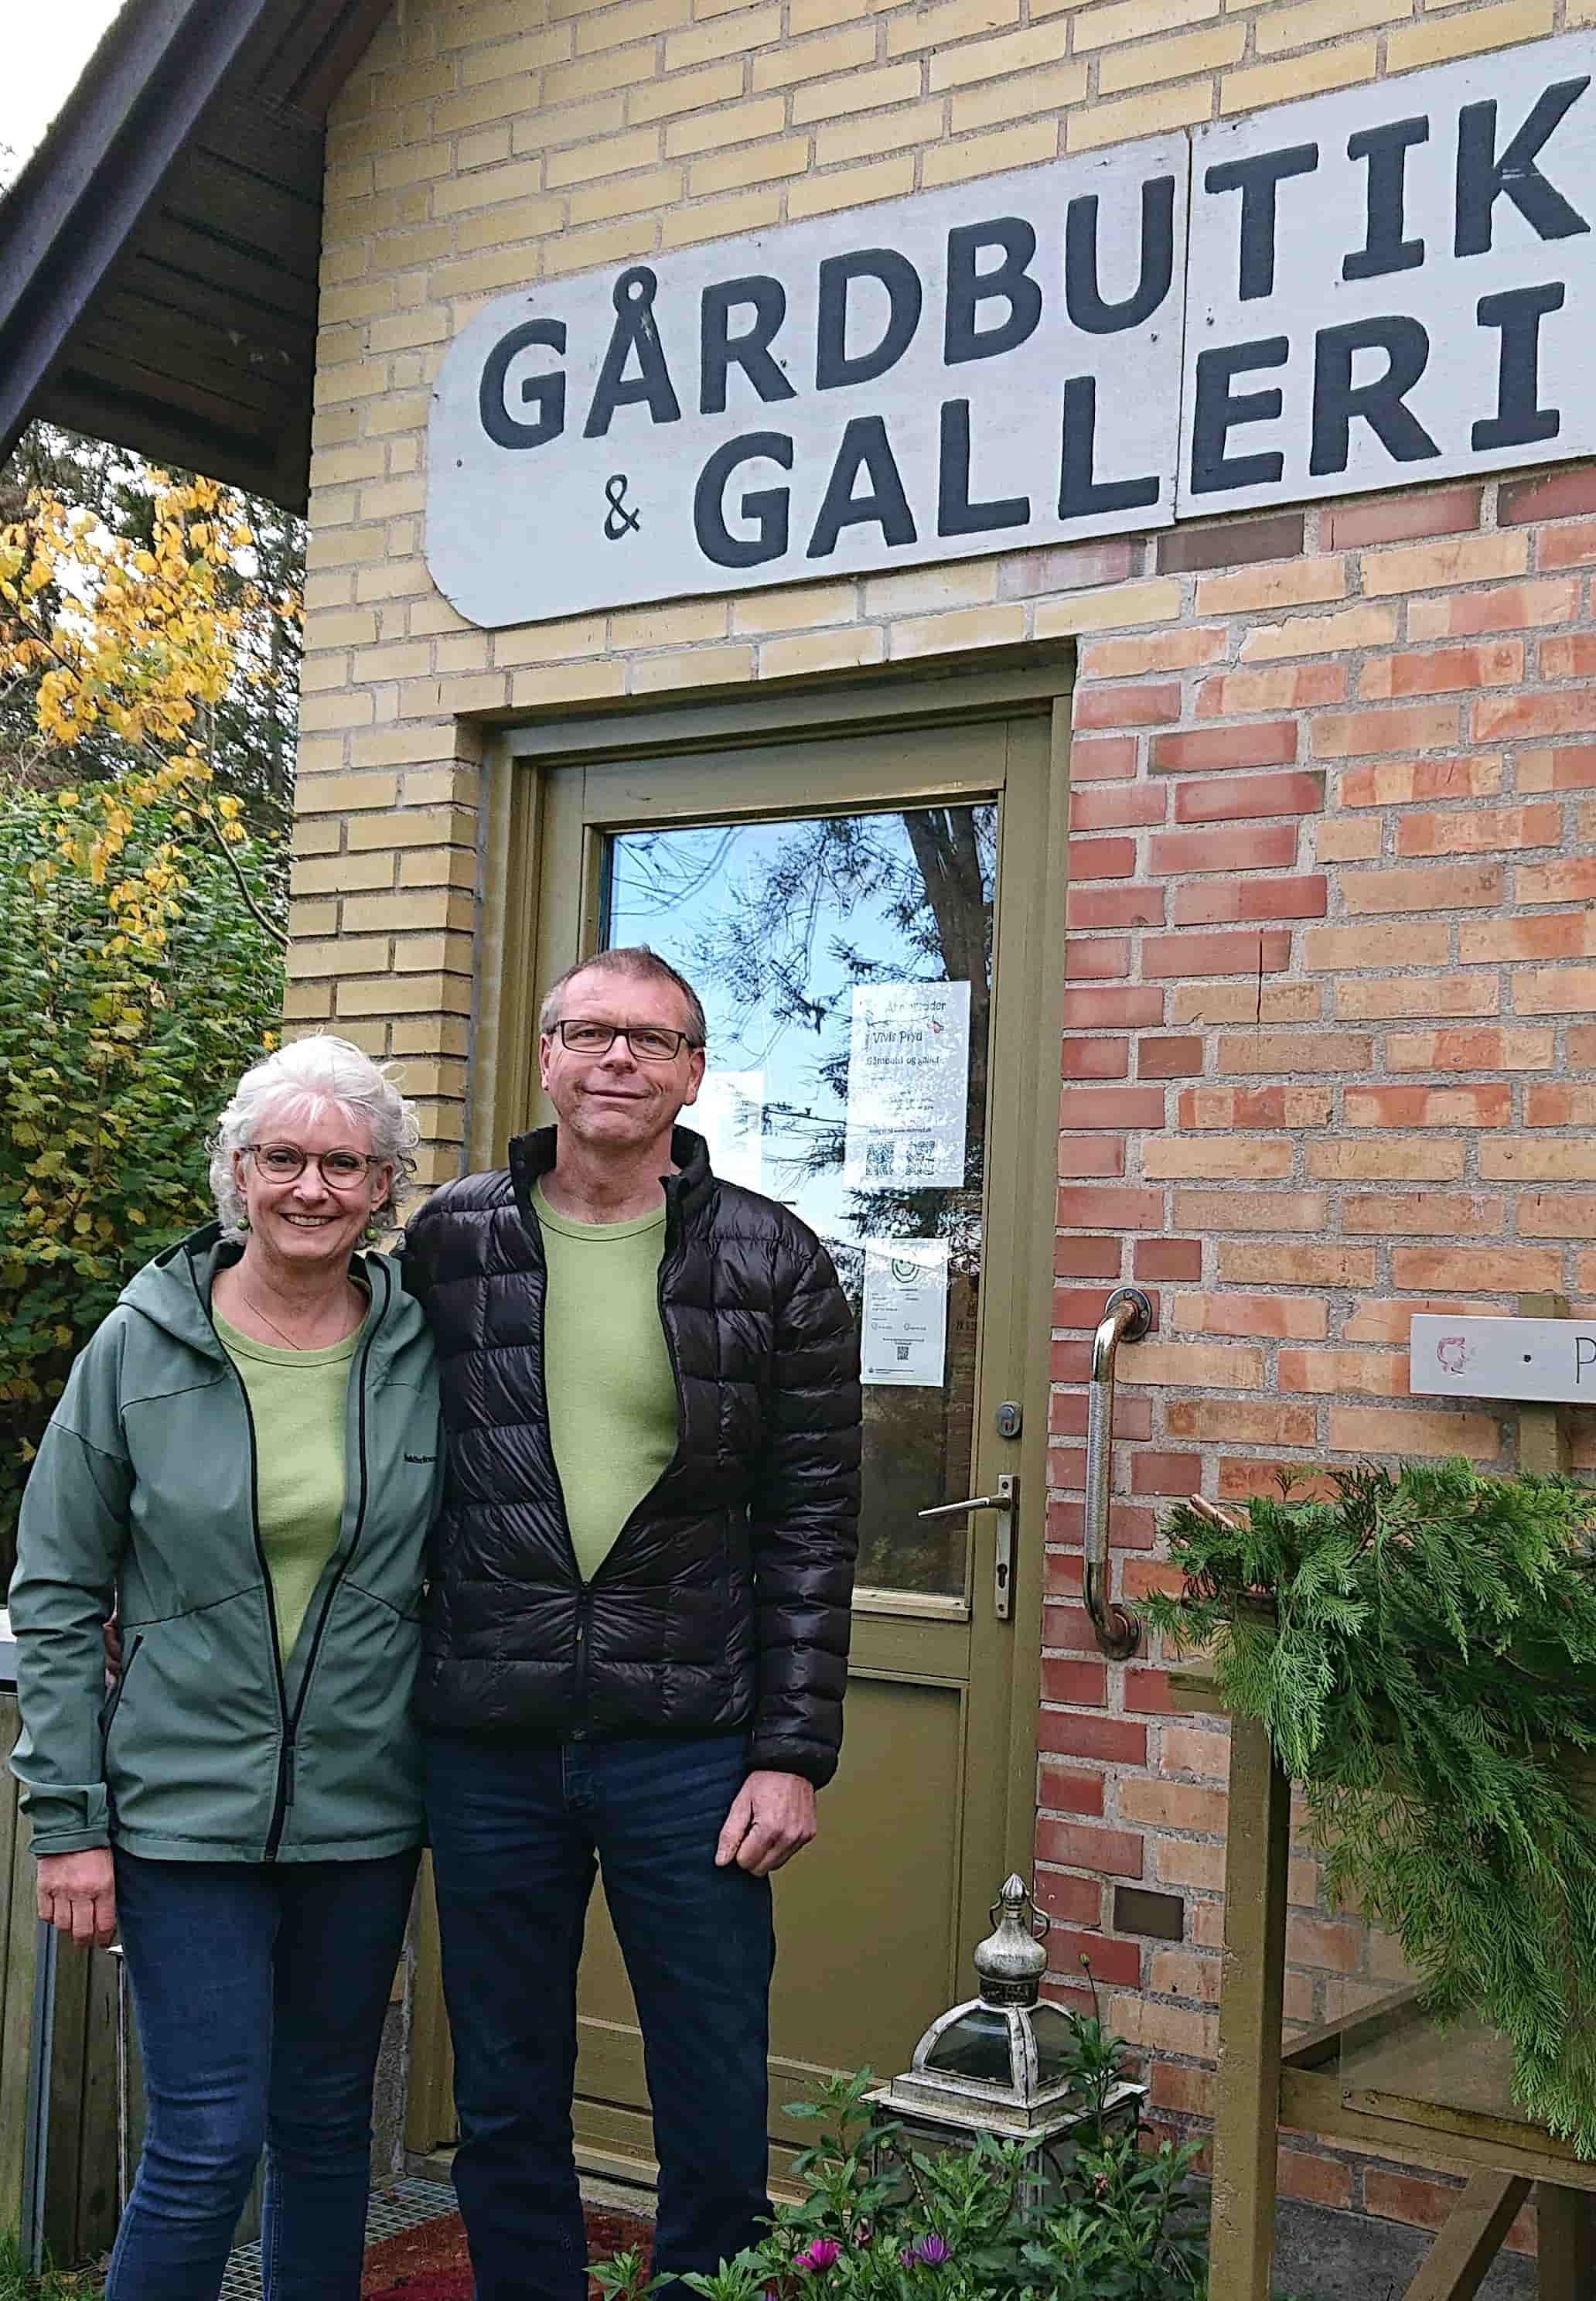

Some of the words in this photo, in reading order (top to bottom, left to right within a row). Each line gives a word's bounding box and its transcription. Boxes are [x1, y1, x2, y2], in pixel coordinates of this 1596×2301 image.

[477, 74, 1593, 449] GÅRDBUTIK
[603, 473, 641, 541] &
[694, 281, 1565, 568] GALLERI
